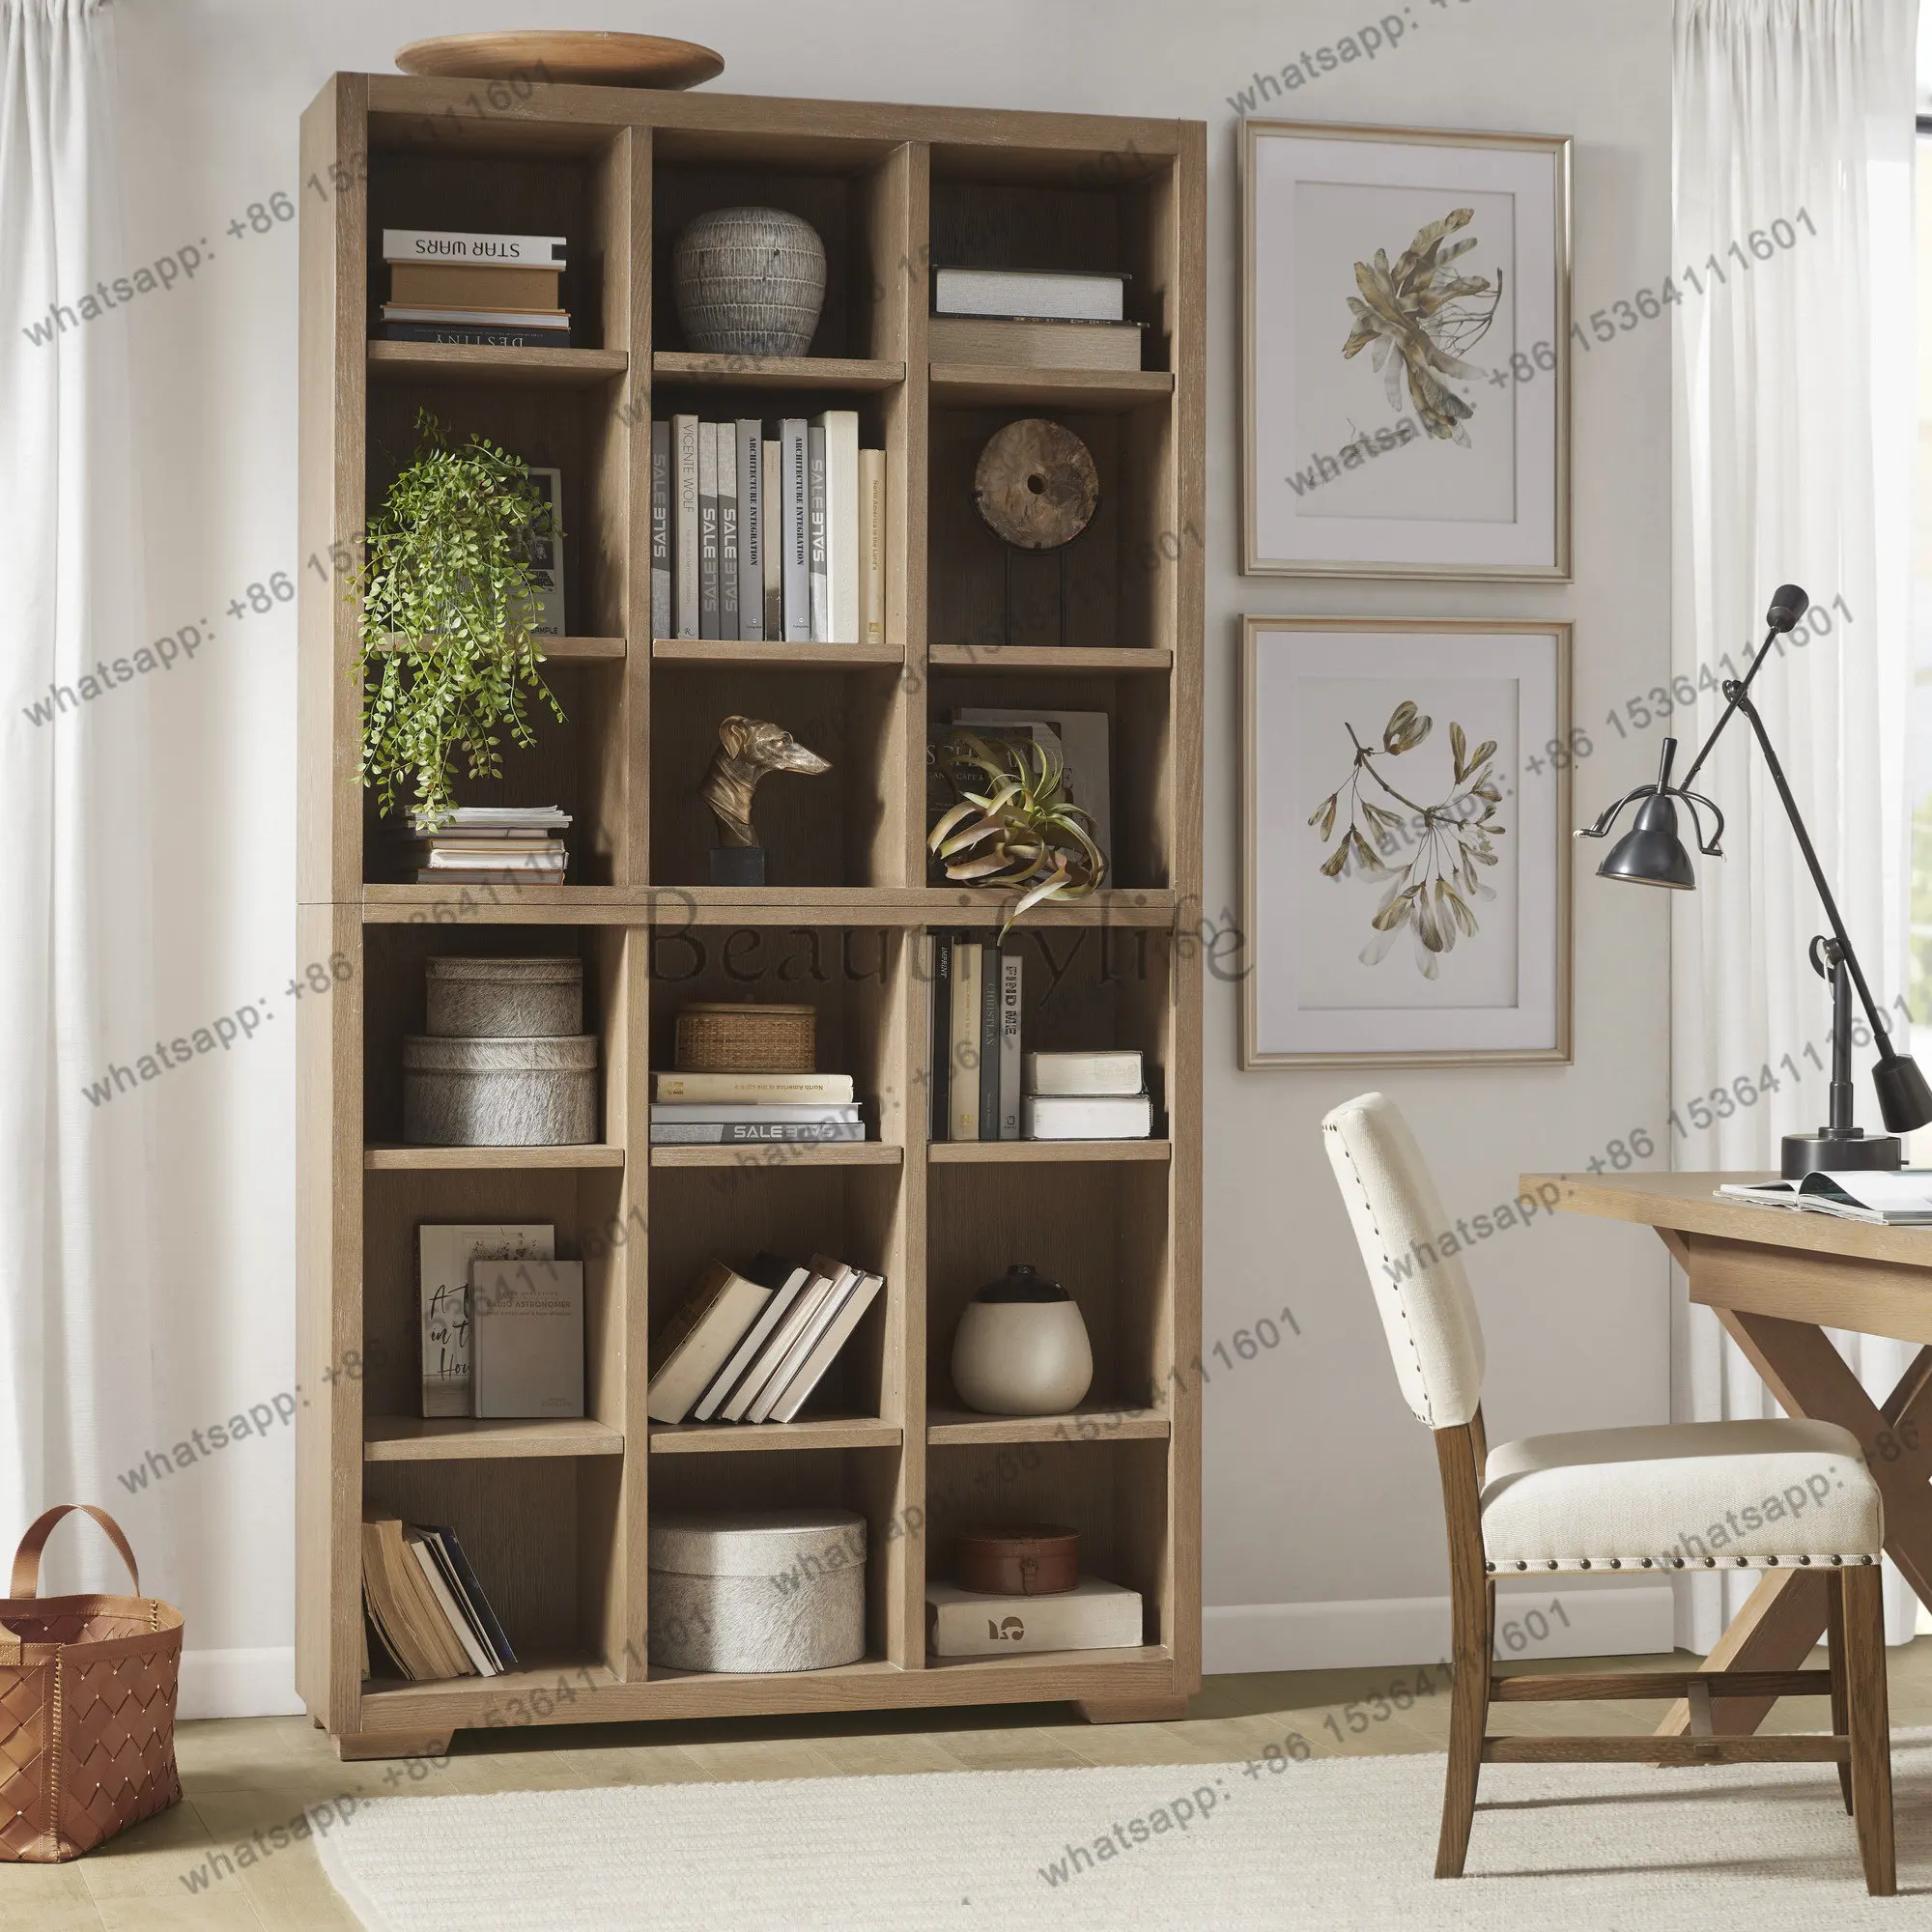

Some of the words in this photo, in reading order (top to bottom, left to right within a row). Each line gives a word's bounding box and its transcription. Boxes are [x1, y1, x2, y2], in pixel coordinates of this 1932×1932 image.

[415, 239, 466, 255] WARS
[472, 241, 521, 257] STAR
[682, 423, 695, 473] VICENTE
[750, 437, 758, 507] ARCHITECTURE
[795, 437, 804, 506] ARCHITECTURE
[682, 477, 695, 514] WOLF
[653, 507, 667, 558] SALE
[703, 508, 716, 558] SALE
[724, 508, 737, 558] SALE
[750, 508, 758, 566] INTEGRATION
[796, 507, 805, 566] INTEGRATION
[812, 512, 825, 562] SALE
[940, 947, 949, 979] IMPRINT
[1005, 966, 1017, 1006] FIND
[1005, 1009, 1017, 1036] ME
[733, 1125, 782, 1139] SALE
